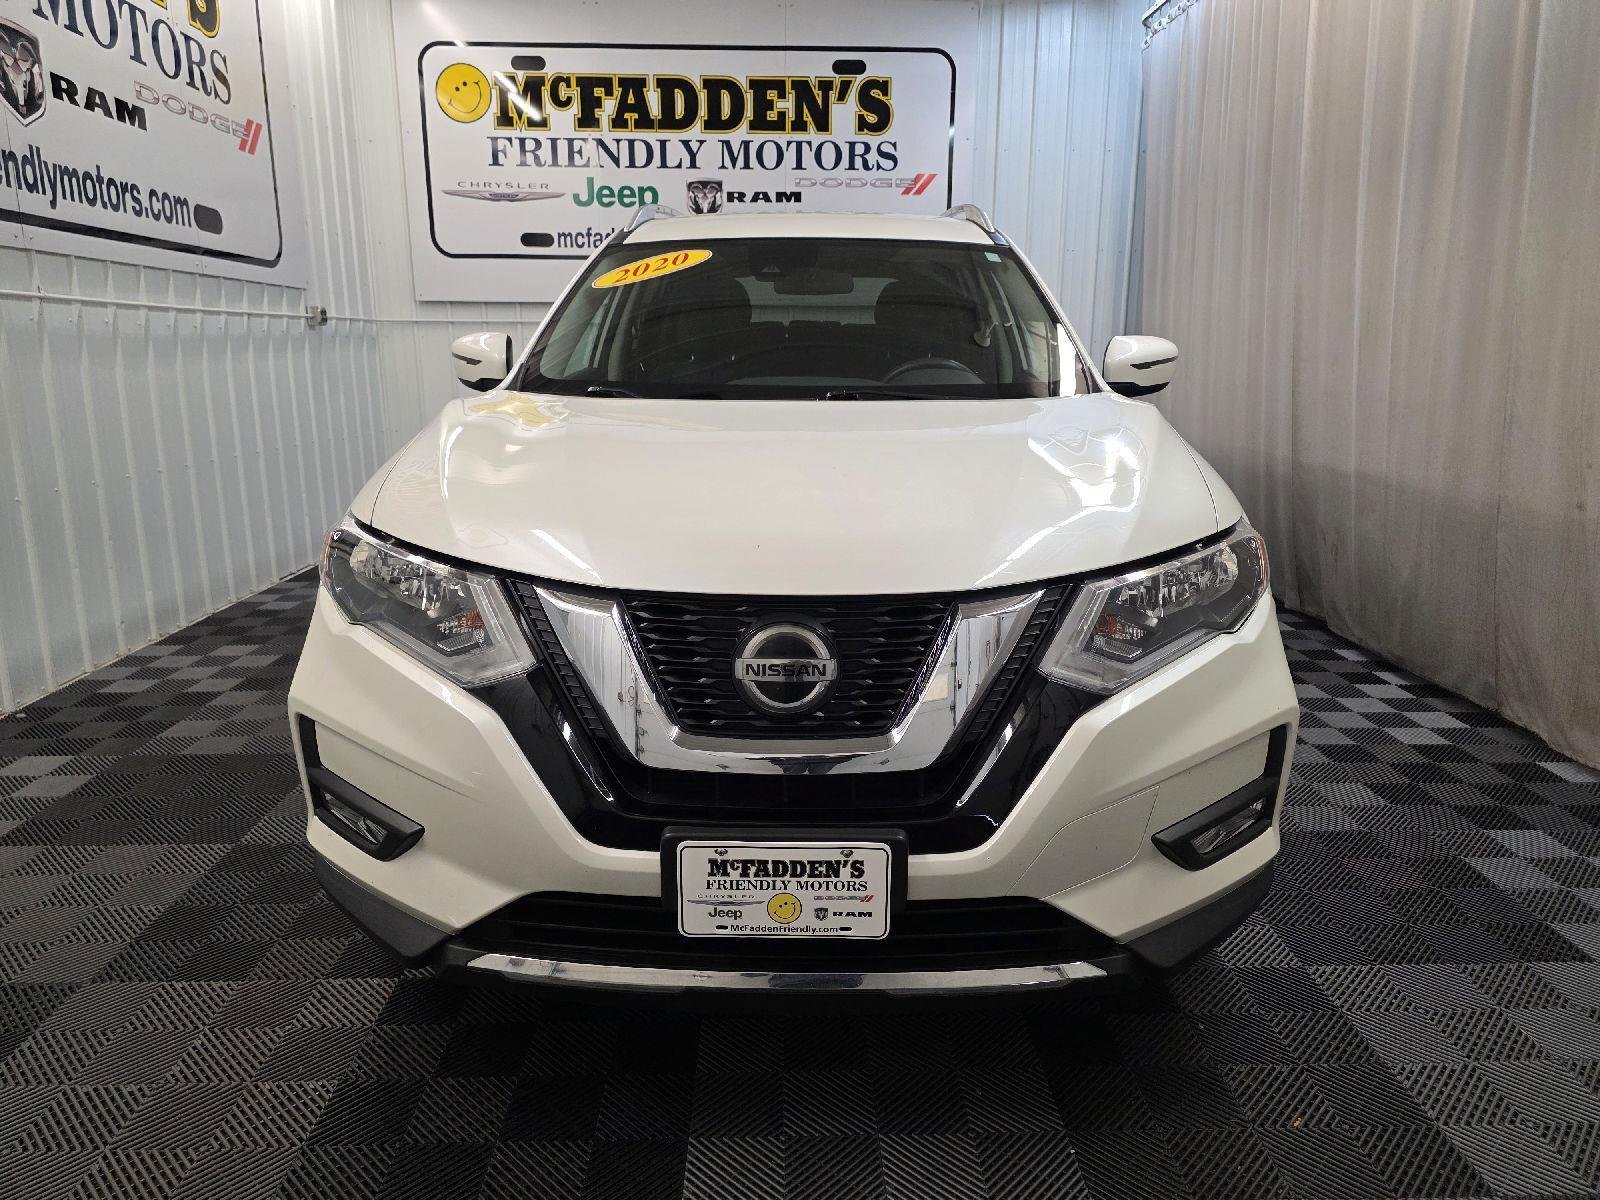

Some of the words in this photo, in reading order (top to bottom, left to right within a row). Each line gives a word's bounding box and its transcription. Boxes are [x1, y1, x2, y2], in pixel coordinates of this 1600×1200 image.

[50, 72, 147, 131] RAM
[134, 80, 250, 139] DODGE
[487, 136, 707, 169] FRIENDLY
[718, 139, 898, 171] MOTORS
[0, 144, 192, 228] ndlymotors.com
[457, 181, 549, 190] CHRYSLER
[795, 178, 917, 188] DODGE
[572, 177, 659, 208] Jeep
[726, 191, 802, 203] RAM
[612, 252, 689, 284] 2020
[745, 663, 827, 677] NISSAN
[705, 879, 791, 891] FRIENDLY
[796, 880, 868, 892] MOTORS
[708, 907, 743, 920] Jeep
[730, 925, 838, 933] McFaddenFriendly.com
